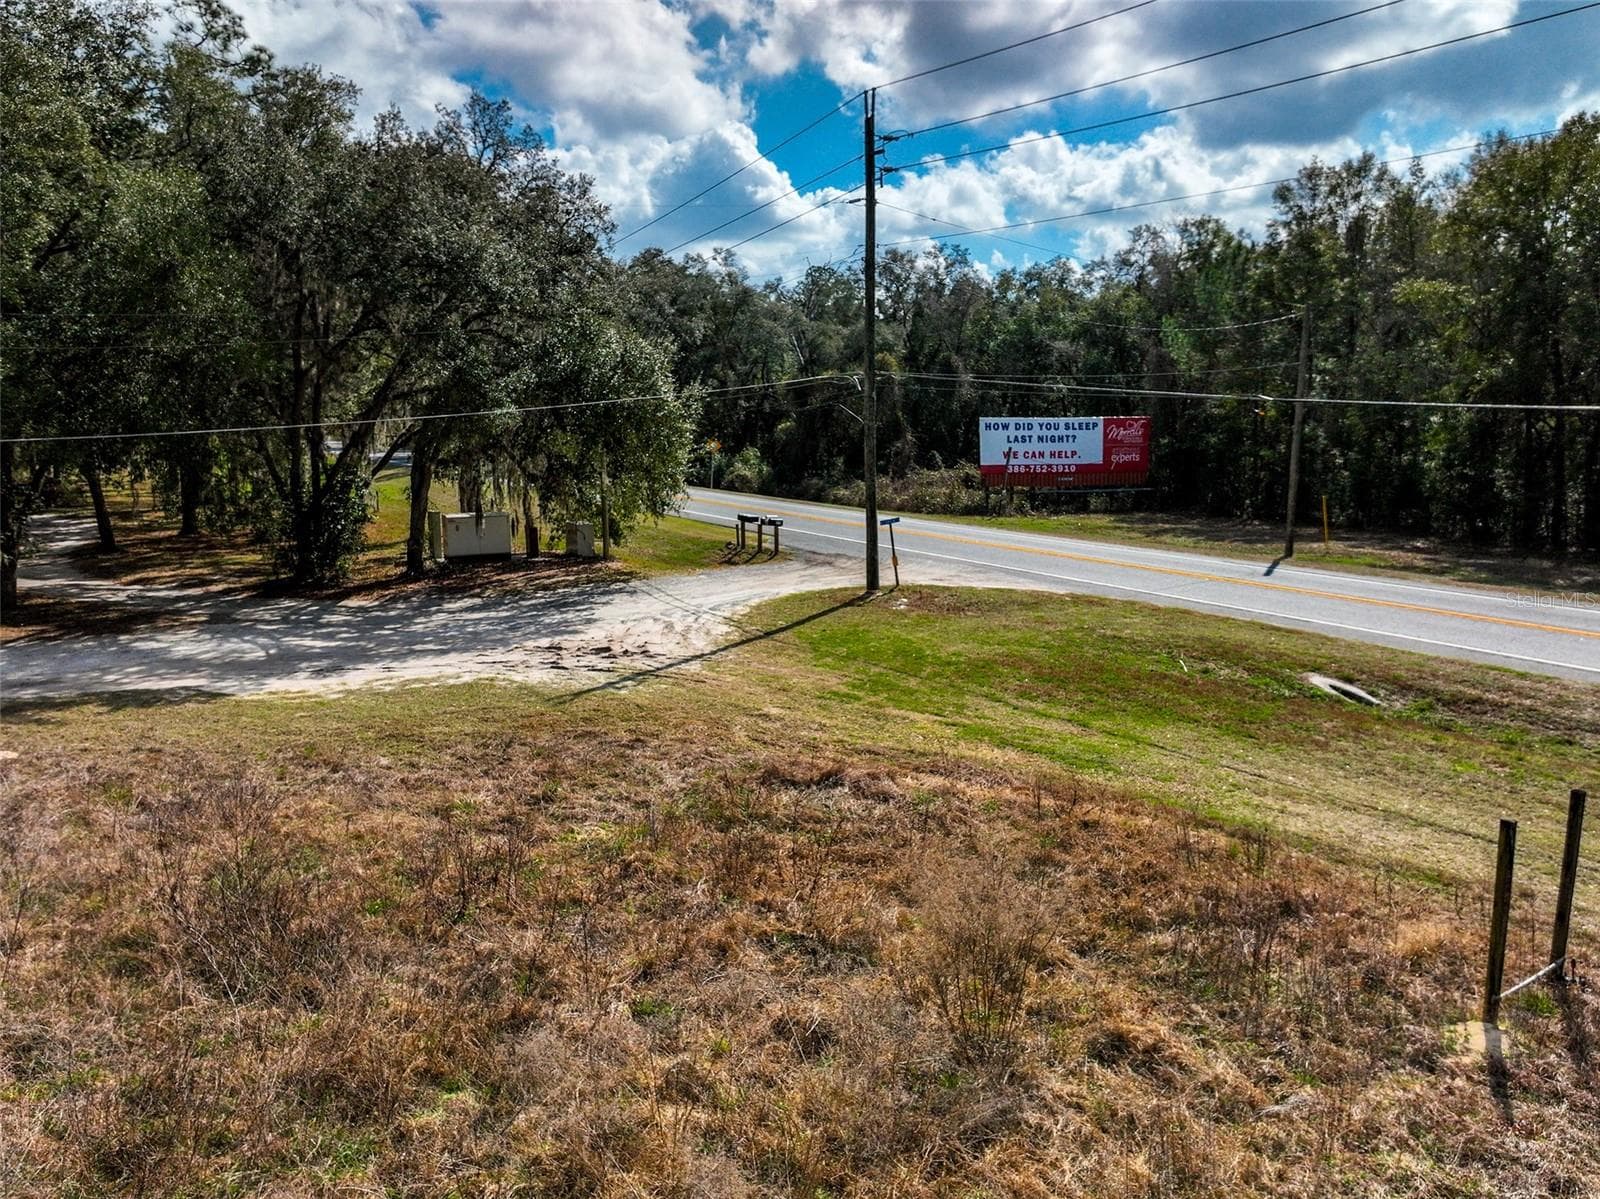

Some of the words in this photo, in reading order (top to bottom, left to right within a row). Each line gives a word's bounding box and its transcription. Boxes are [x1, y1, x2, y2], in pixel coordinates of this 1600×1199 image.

[984, 422, 1010, 431] HOW
[1014, 422, 1034, 431] DID
[1038, 422, 1060, 431] YOU
[1064, 422, 1099, 431] SLEEP
[1006, 435, 1033, 444] LAST
[1037, 435, 1077, 443] NIGHT?
[1023, 451, 1045, 459] CAN
[1050, 450, 1081, 459] HELP.
[1111, 453, 1140, 465] experts
[1007, 465, 1076, 473] 386-752-3910
